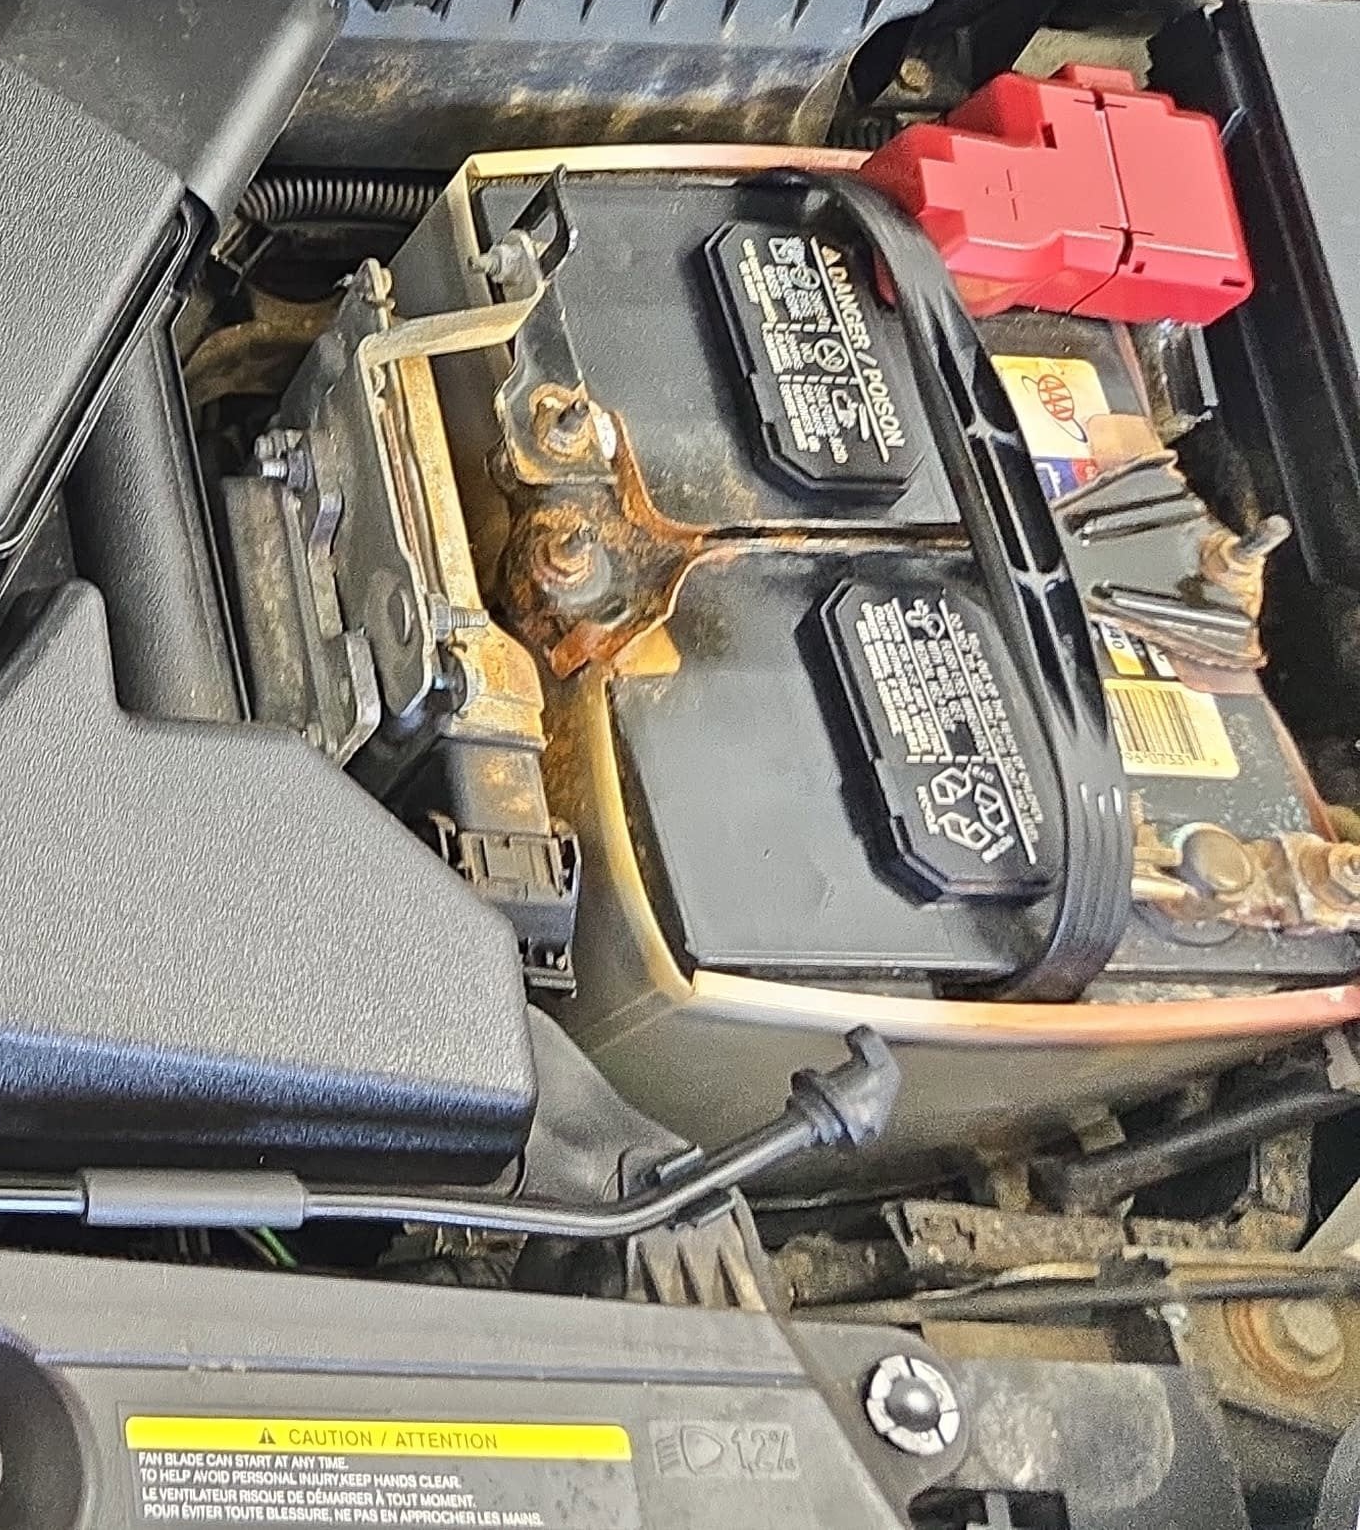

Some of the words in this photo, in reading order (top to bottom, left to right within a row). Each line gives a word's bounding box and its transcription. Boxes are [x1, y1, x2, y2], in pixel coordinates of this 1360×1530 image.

[829, 267, 871, 349] DANGER
[863, 370, 906, 447] POISON
[1041, 378, 1071, 416] AAA
[288, 1428, 372, 1447] CAUTION
[396, 1431, 498, 1449] ATTENTION
[138, 1452, 162, 1466] FAN
[164, 1453, 204, 1467] BLADE
[206, 1453, 232, 1467] CAN
[235, 1454, 272, 1468] START
[274, 1454, 290, 1469] AT
[291, 1455, 316, 1469] ANY
[318, 1455, 349, 1470] TIME.
[141, 1469, 157, 1483] TO
[159, 1469, 191, 1484] HELP
[192, 1470, 229, 1485] AVOID
[232, 1471, 297, 1486] PERSONAL
[374, 1473, 417, 1488] HANDS
[419, 1475, 462, 1489] CLEAR.
[142, 1487, 158, 1501] LE
[159, 1488, 237, 1503] VENTILATEUR
[239, 1489, 285, 1504] RISQUE
[287, 1490, 305, 1504] DE
[307, 1488, 373, 1505] DÉMARRER
[375, 1488, 384, 1506] À
[385, 1492, 418, 1507] TOUT
[420, 1493, 477, 1508] MOMENT.
[144, 1504, 179, 1519] POUR
[181, 1501, 222, 1520] ÉVITER
[224, 1505, 264, 1520] TOUTE
[266, 1506, 333, 1522] BLESSURE,
[335, 1507, 351, 1521] NE
[354, 1508, 378, 1522] PAS
[380, 1509, 398, 1523] EN
[399, 1509, 479, 1525] APPROCHER
[480, 1511, 500, 1525] LES
[502, 1512, 544, 1527] MAINS.
